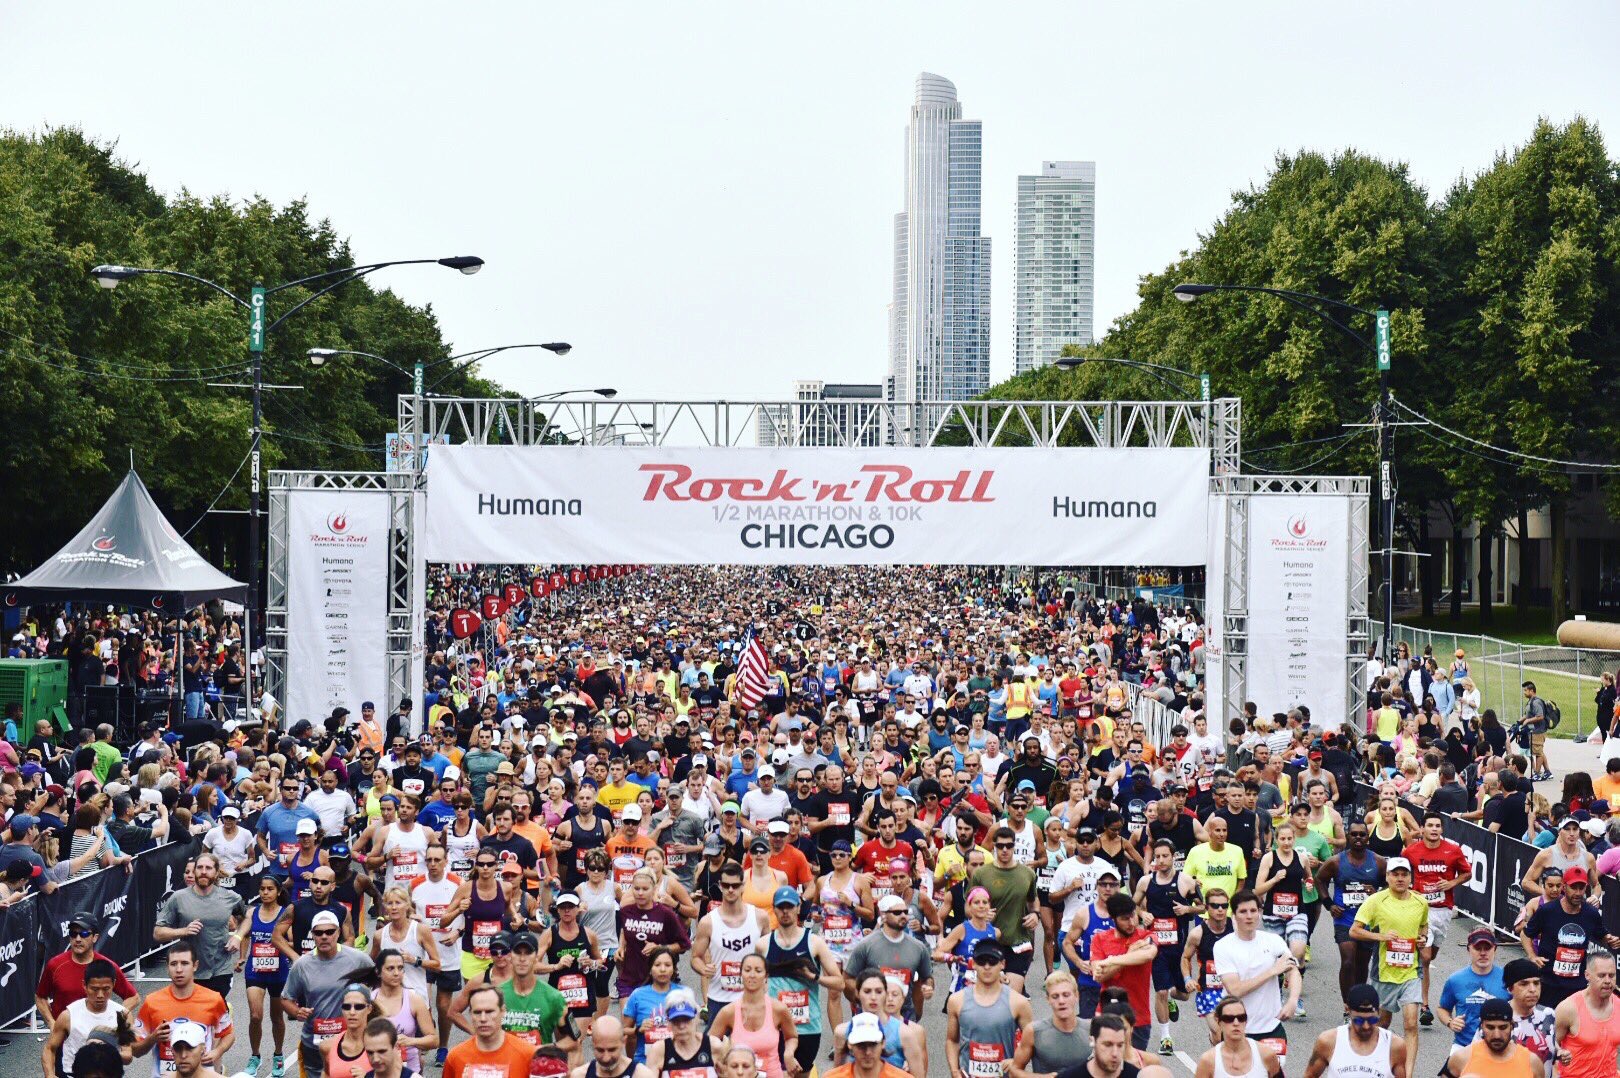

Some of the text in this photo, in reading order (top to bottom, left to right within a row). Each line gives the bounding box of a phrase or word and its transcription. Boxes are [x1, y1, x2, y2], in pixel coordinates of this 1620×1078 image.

[252, 293, 264, 345] C141
[1377, 316, 1390, 364] C140
[638, 463, 806, 501] Rock
[860, 464, 996, 502] Roll
[477, 493, 582, 515] Humana
[1053, 495, 1157, 518] Humana
[712, 505, 923, 522] 1/2 MARATHON & 10K
[740, 523, 896, 549] CHICAGO
[554, 579, 560, 588] 5
[537, 584, 544, 594] 4
[510, 592, 516, 602] 3
[491, 604, 498, 614] 2
[770, 606, 776, 614] 5
[461, 618, 468, 632] 1
[800, 628, 806, 638] 4
[1418, 864, 1448, 873] RMHC
[624, 918, 664, 932] MAROON
[722, 936, 751, 952] USA
[1391, 952, 1410, 961] 4124
[256, 958, 275, 966] 3050
[564, 990, 583, 998] 3033
[972, 1062, 1000, 1072] 14262
[1337, 1065, 1357, 1074] THREE
[1359, 1065, 1373, 1074] RUN
